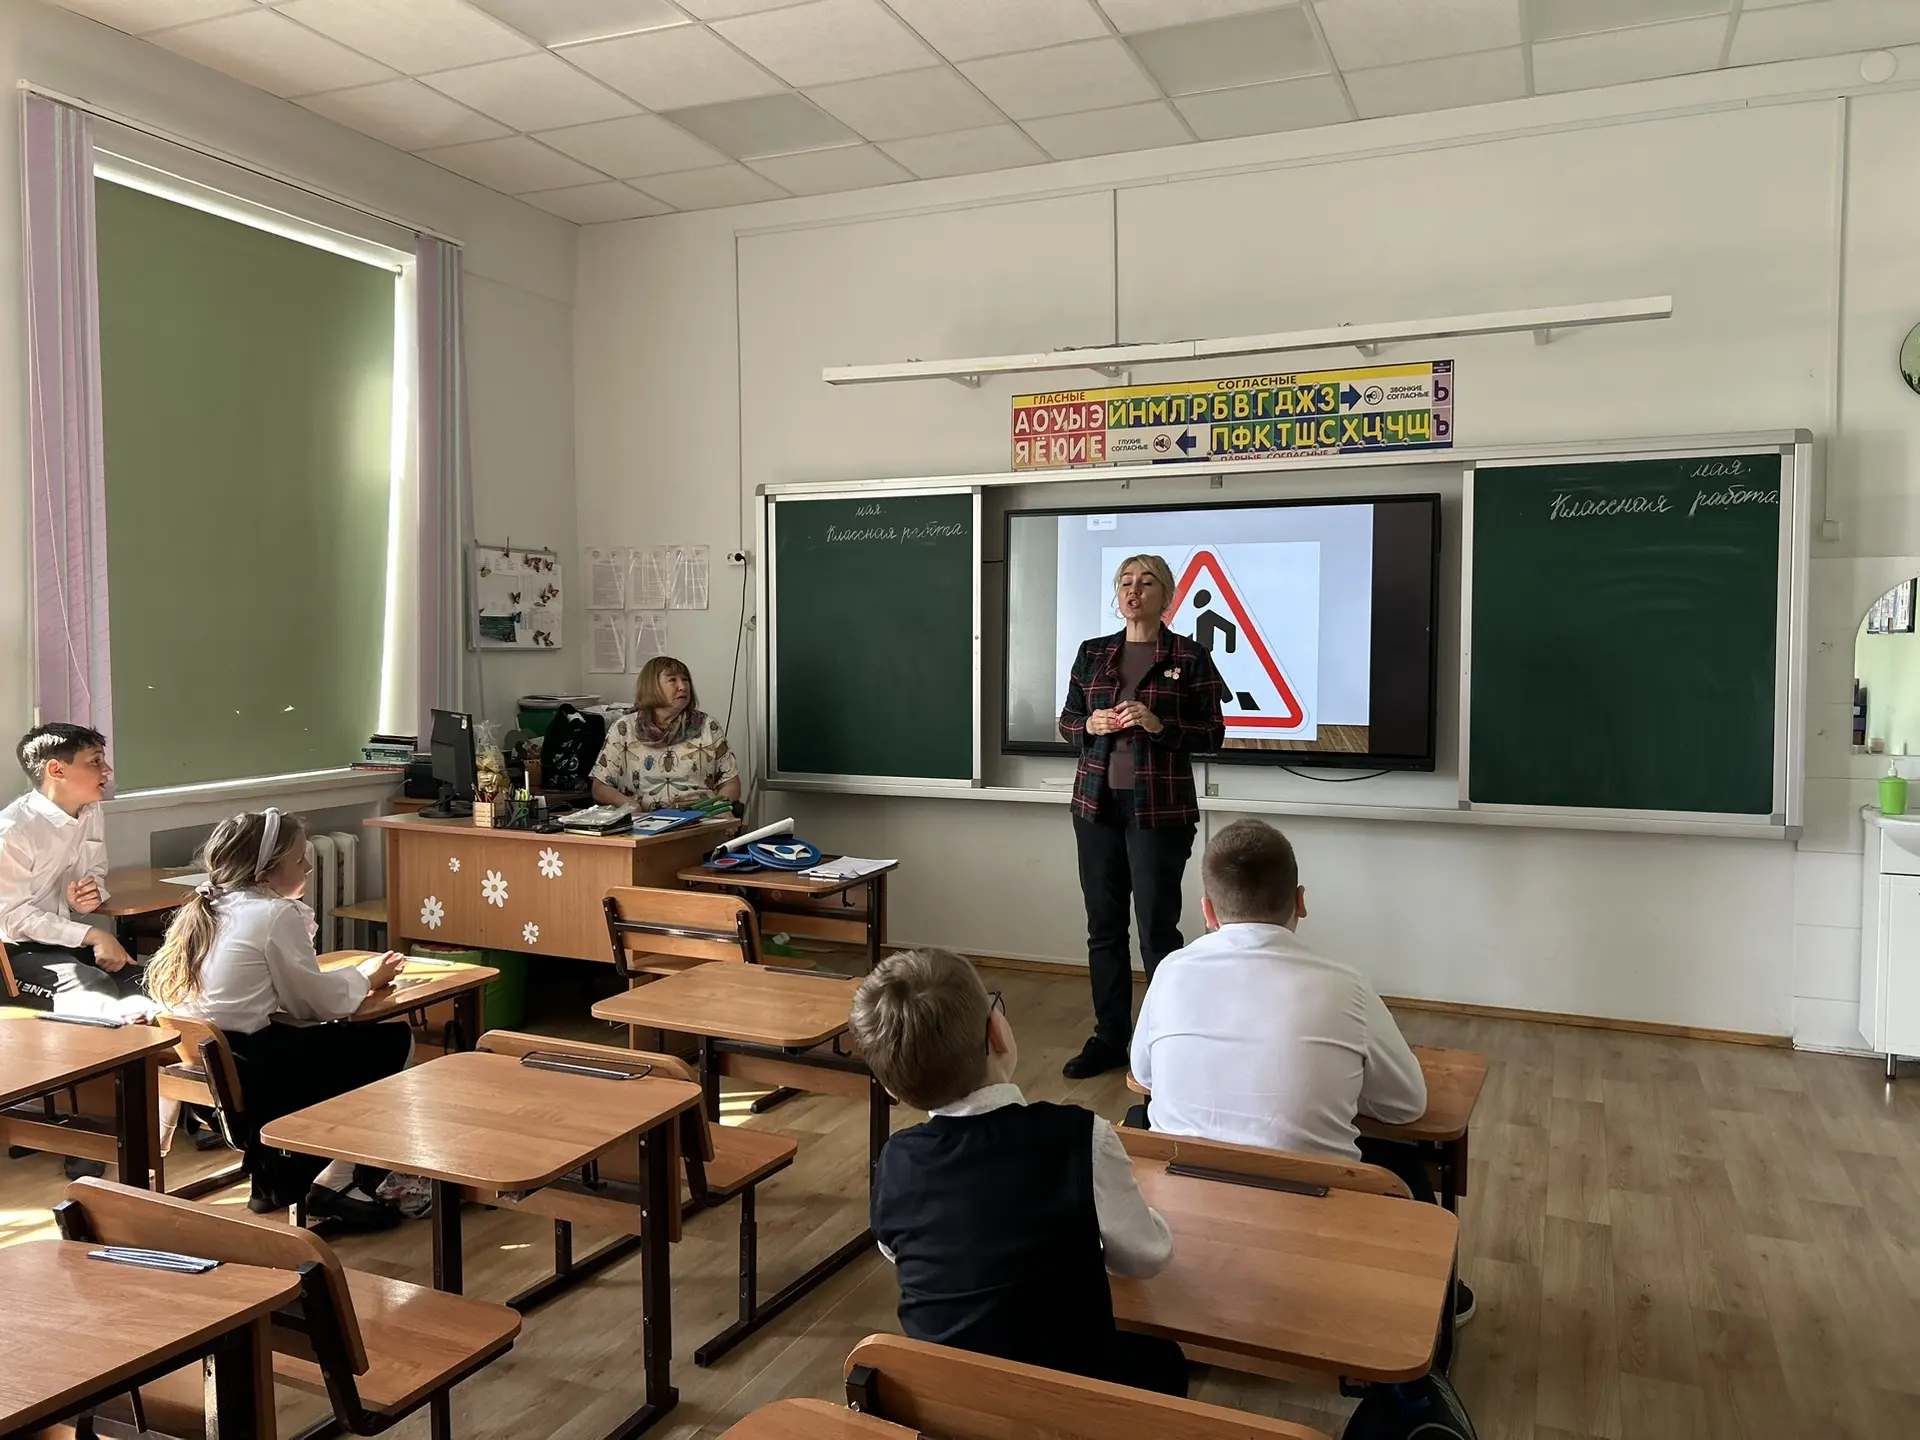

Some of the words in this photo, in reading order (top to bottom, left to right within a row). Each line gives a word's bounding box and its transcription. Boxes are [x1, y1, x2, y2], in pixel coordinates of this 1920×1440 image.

[1217, 375, 1297, 390] СОГЛАСНЫЕ
[1389, 385, 1422, 393] ЗВОНКИЕ
[1033, 392, 1086, 405] ГЛАСНЫЕ
[1387, 391, 1429, 400] СОГЛАСНЫЕ
[1111, 444, 1148, 452] СОГЛАСНЫЕ
[1550, 493, 1674, 520] Классная
[826, 524, 898, 543] Классная
